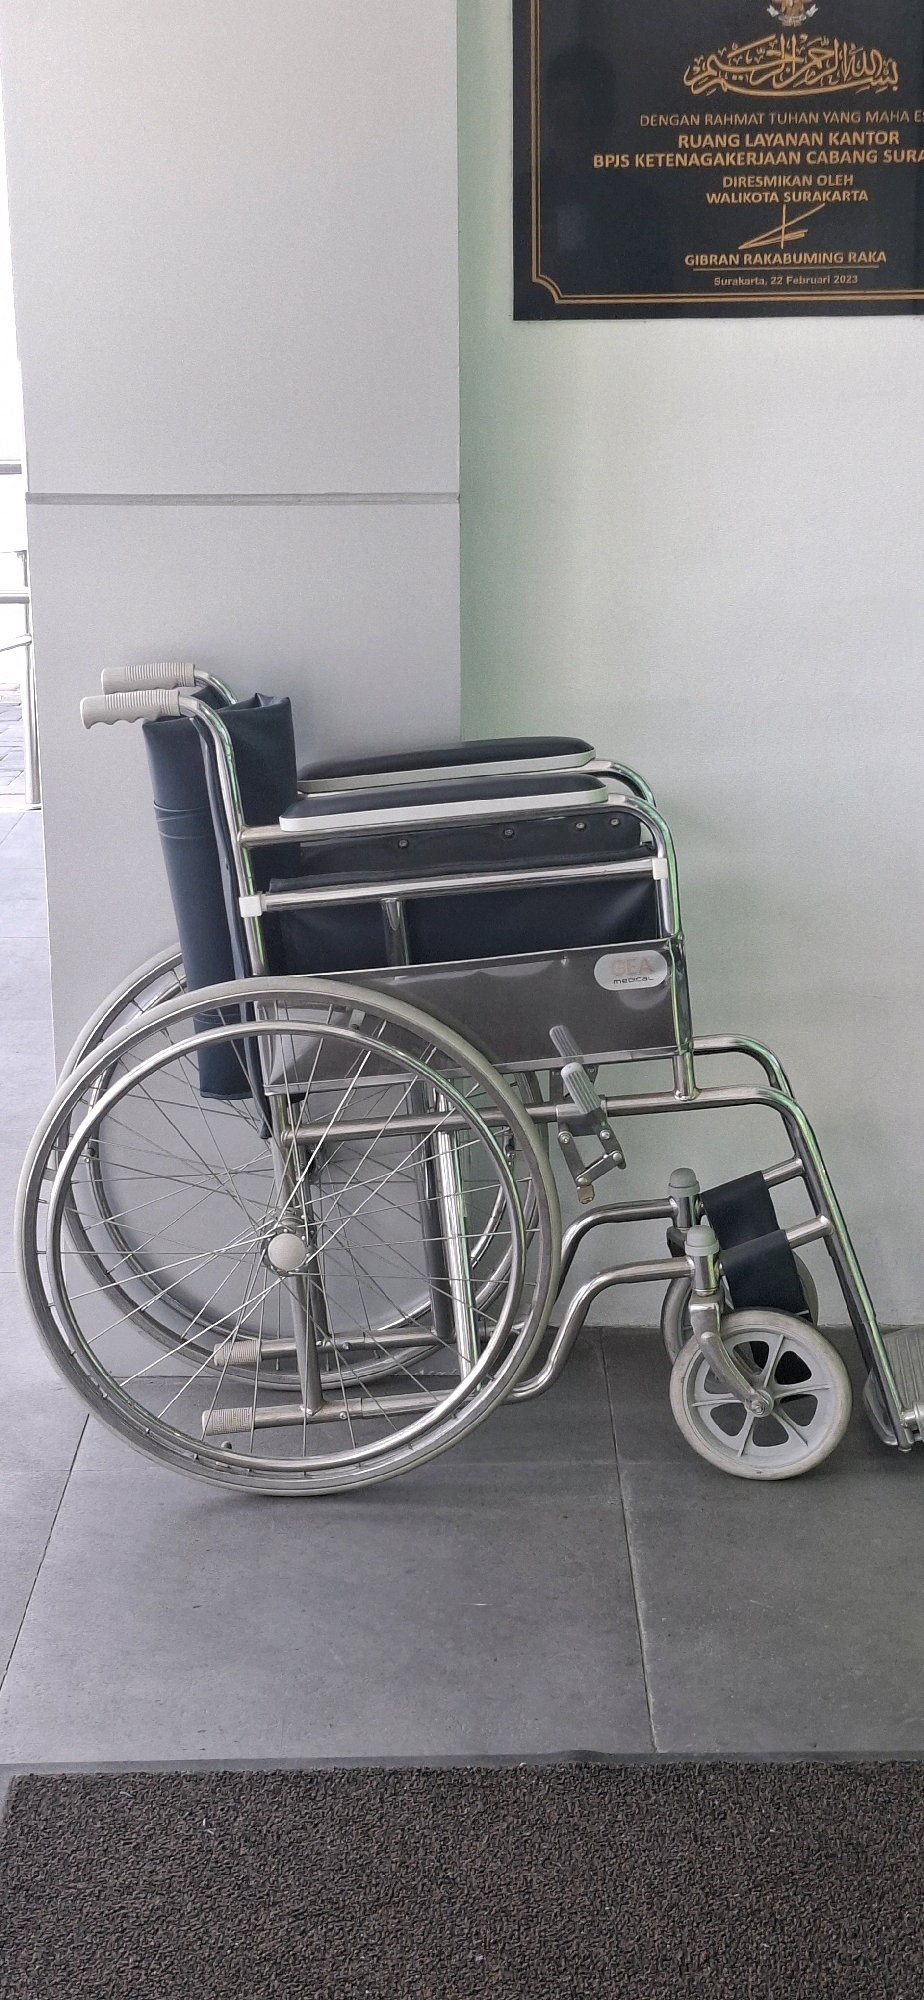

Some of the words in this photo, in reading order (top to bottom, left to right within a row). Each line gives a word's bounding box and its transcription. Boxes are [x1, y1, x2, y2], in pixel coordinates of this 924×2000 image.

[640, 113, 700, 127] DENGAN
[704, 112, 765, 126] RAHMAT
[769, 111, 819, 125] TUHAN
[822, 110, 861, 124] YANG
[865, 109, 910, 123] MAHA
[914, 109, 924, 123] E
[678, 133, 740, 149] RUANG
[745, 131, 824, 147] LAYANAN
[828, 130, 900, 146] KANTOR
[593, 153, 630, 169] BPJS
[635, 151, 801, 168] KETENAGAKERJAAN
[805, 150, 878, 165] CABANG
[722, 175, 813, 189] DIRESMIKAN
[816, 174, 854, 187] OLEH
[706, 191, 780, 204] WALIKOTA
[783, 190, 869, 203] SURAKARTA
[684, 253, 740, 267] GIBRAN
[743, 251, 844, 266] RAKABUMING
[847, 250, 887, 264] RAKA
[714, 276, 768, 287] Surakarta,
[770, 275, 783, 285] 22
[786, 273, 831, 285] Februari
[833, 274, 858, 285] 2023
